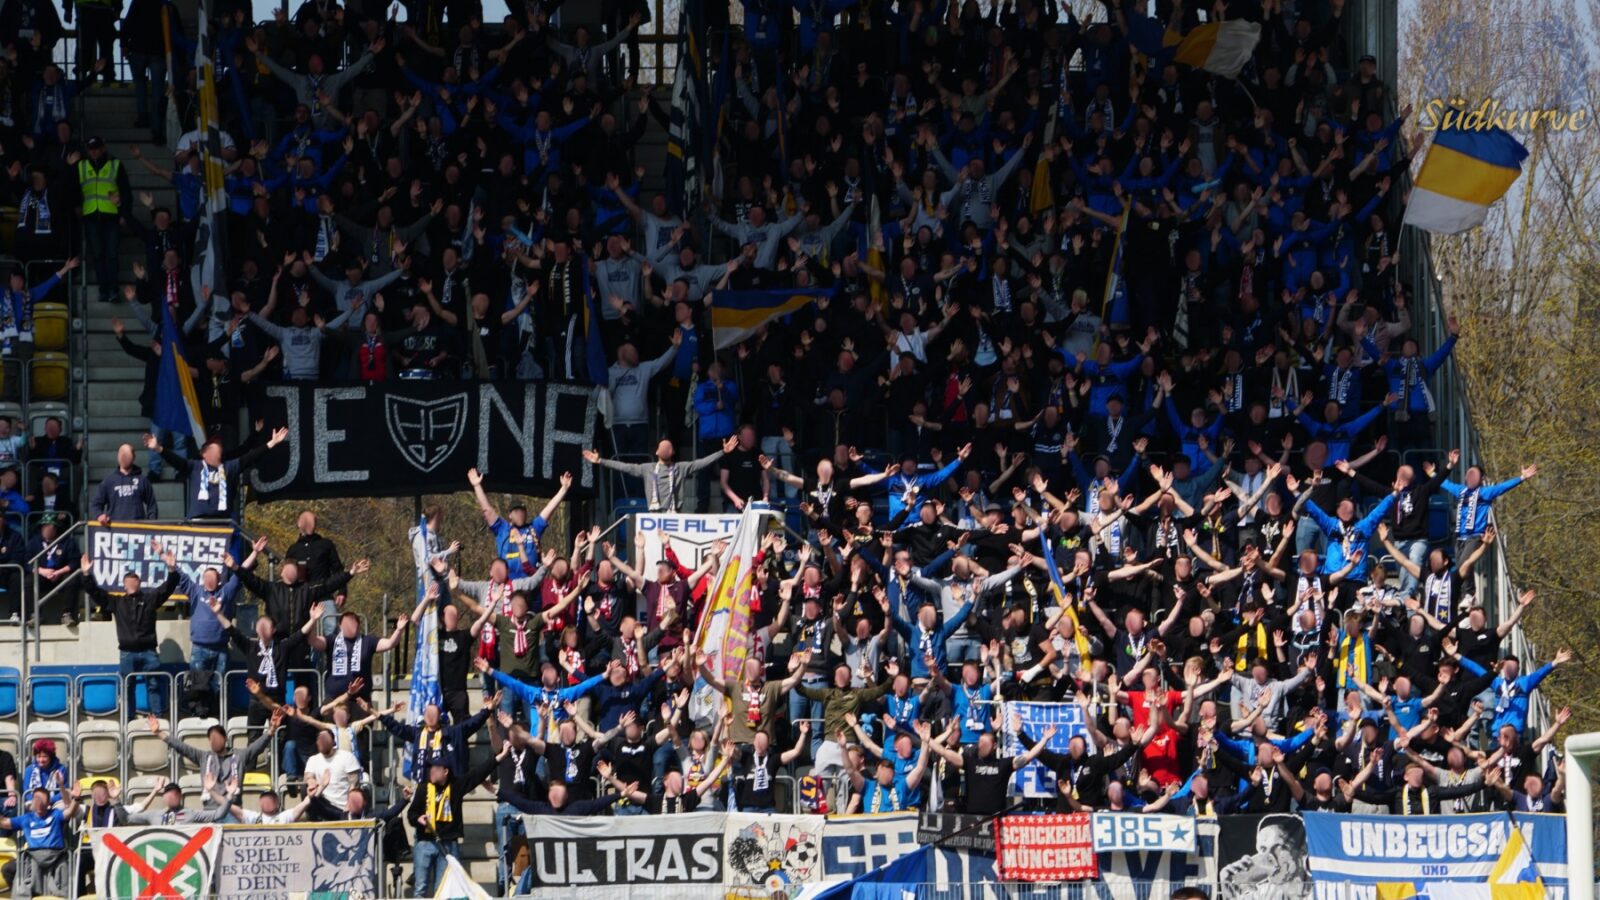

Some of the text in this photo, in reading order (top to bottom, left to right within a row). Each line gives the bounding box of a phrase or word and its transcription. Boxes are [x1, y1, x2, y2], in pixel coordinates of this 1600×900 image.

[640, 518, 740, 533] DIE ALT
[94, 532, 226, 564] REFUGEES
[1001, 825, 1092, 845] SCHICKERIA
[1096, 815, 1163, 847] 385
[222, 834, 303, 847] NUTZE DAS
[234, 848, 290, 863] SPIEL
[534, 837, 721, 884] ULTRAS
[1002, 845, 1093, 869] MÜNCHEN
[222, 863, 301, 876] ES KÖNNTE
[1421, 865, 1449, 876] UND
[237, 875, 288, 890] DEIN
